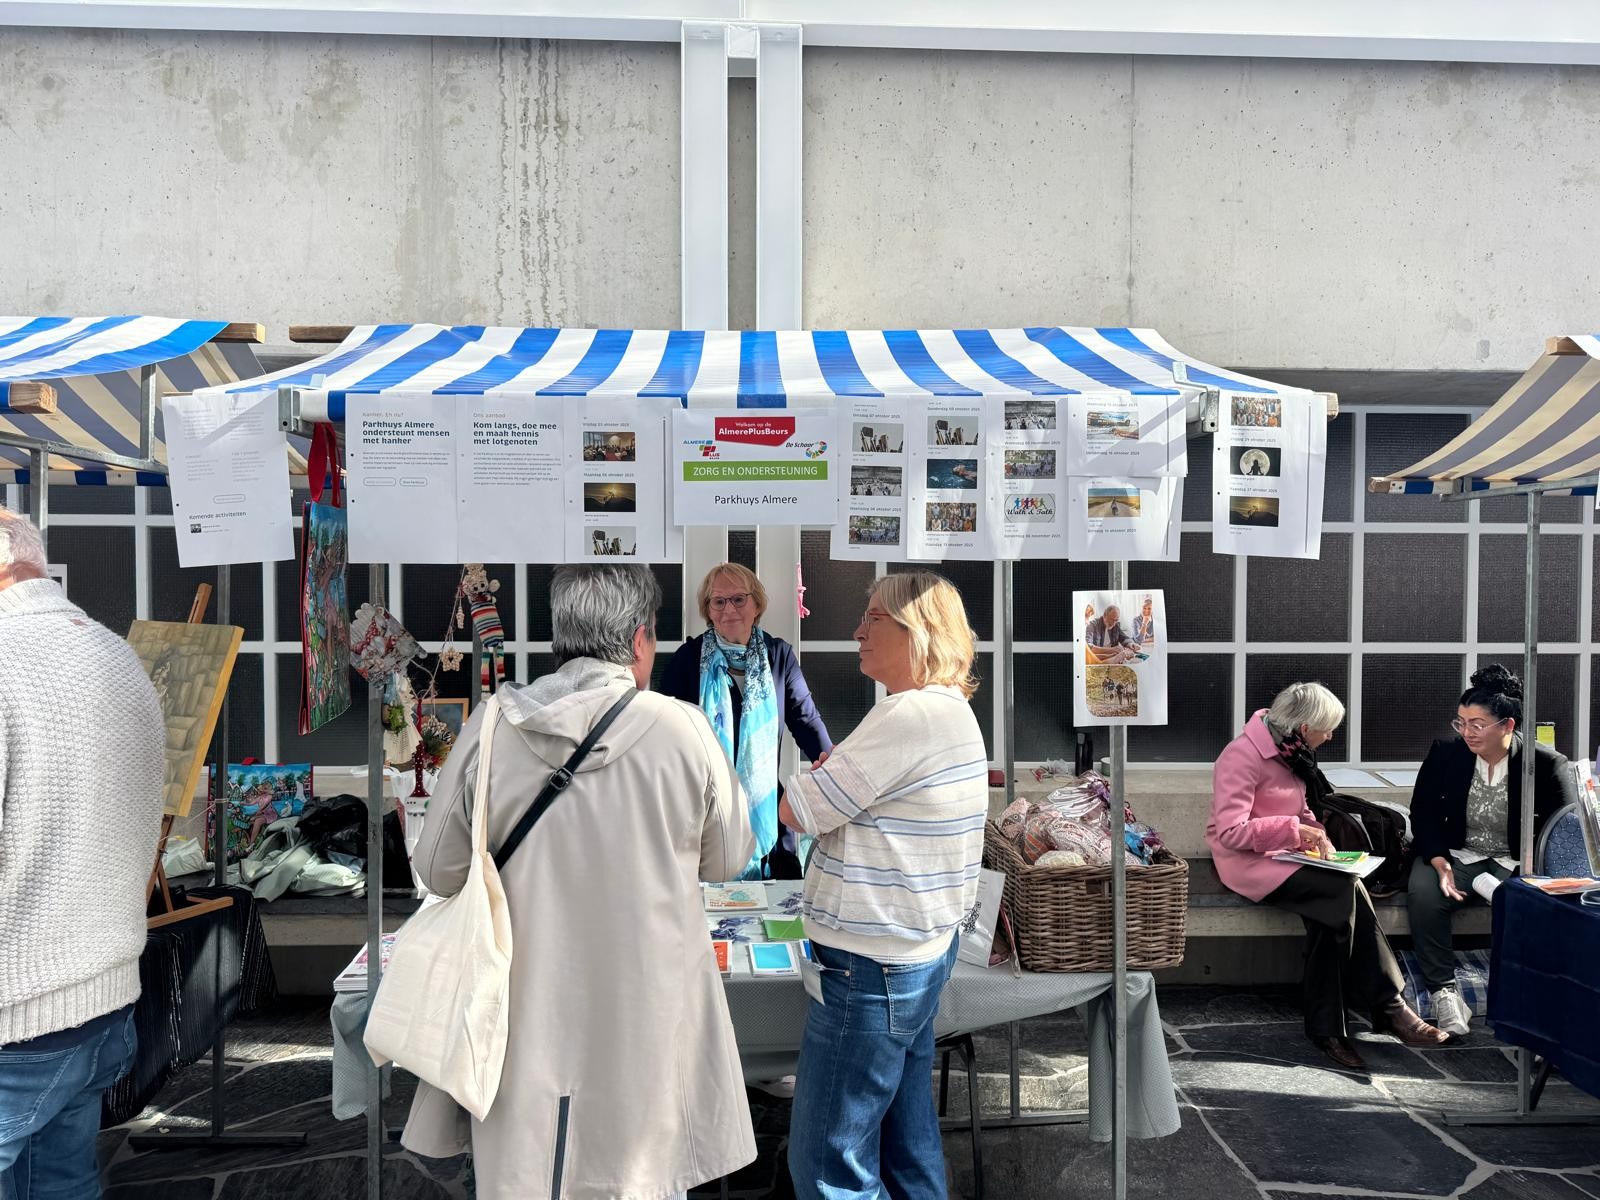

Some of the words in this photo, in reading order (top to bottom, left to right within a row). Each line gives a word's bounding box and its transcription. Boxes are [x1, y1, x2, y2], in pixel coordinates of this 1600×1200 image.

[363, 421, 402, 429] Parkhuys
[405, 421, 435, 429] Almere
[473, 421, 492, 429] Kom
[494, 421, 520, 431] langs,
[522, 422, 538, 430] doe
[511, 430, 539, 438] kennis
[718, 428, 789, 436] AlmerePlusBeurs
[492, 438, 538, 447] lotgenoten
[693, 466, 720, 476] ZORG
[722, 466, 735, 476] EN
[737, 466, 818, 476] ONDERSTEUNING
[714, 495, 760, 506] Parkhuys
[762, 495, 798, 504] Almere
[215, 511, 247, 519] activiteiten
